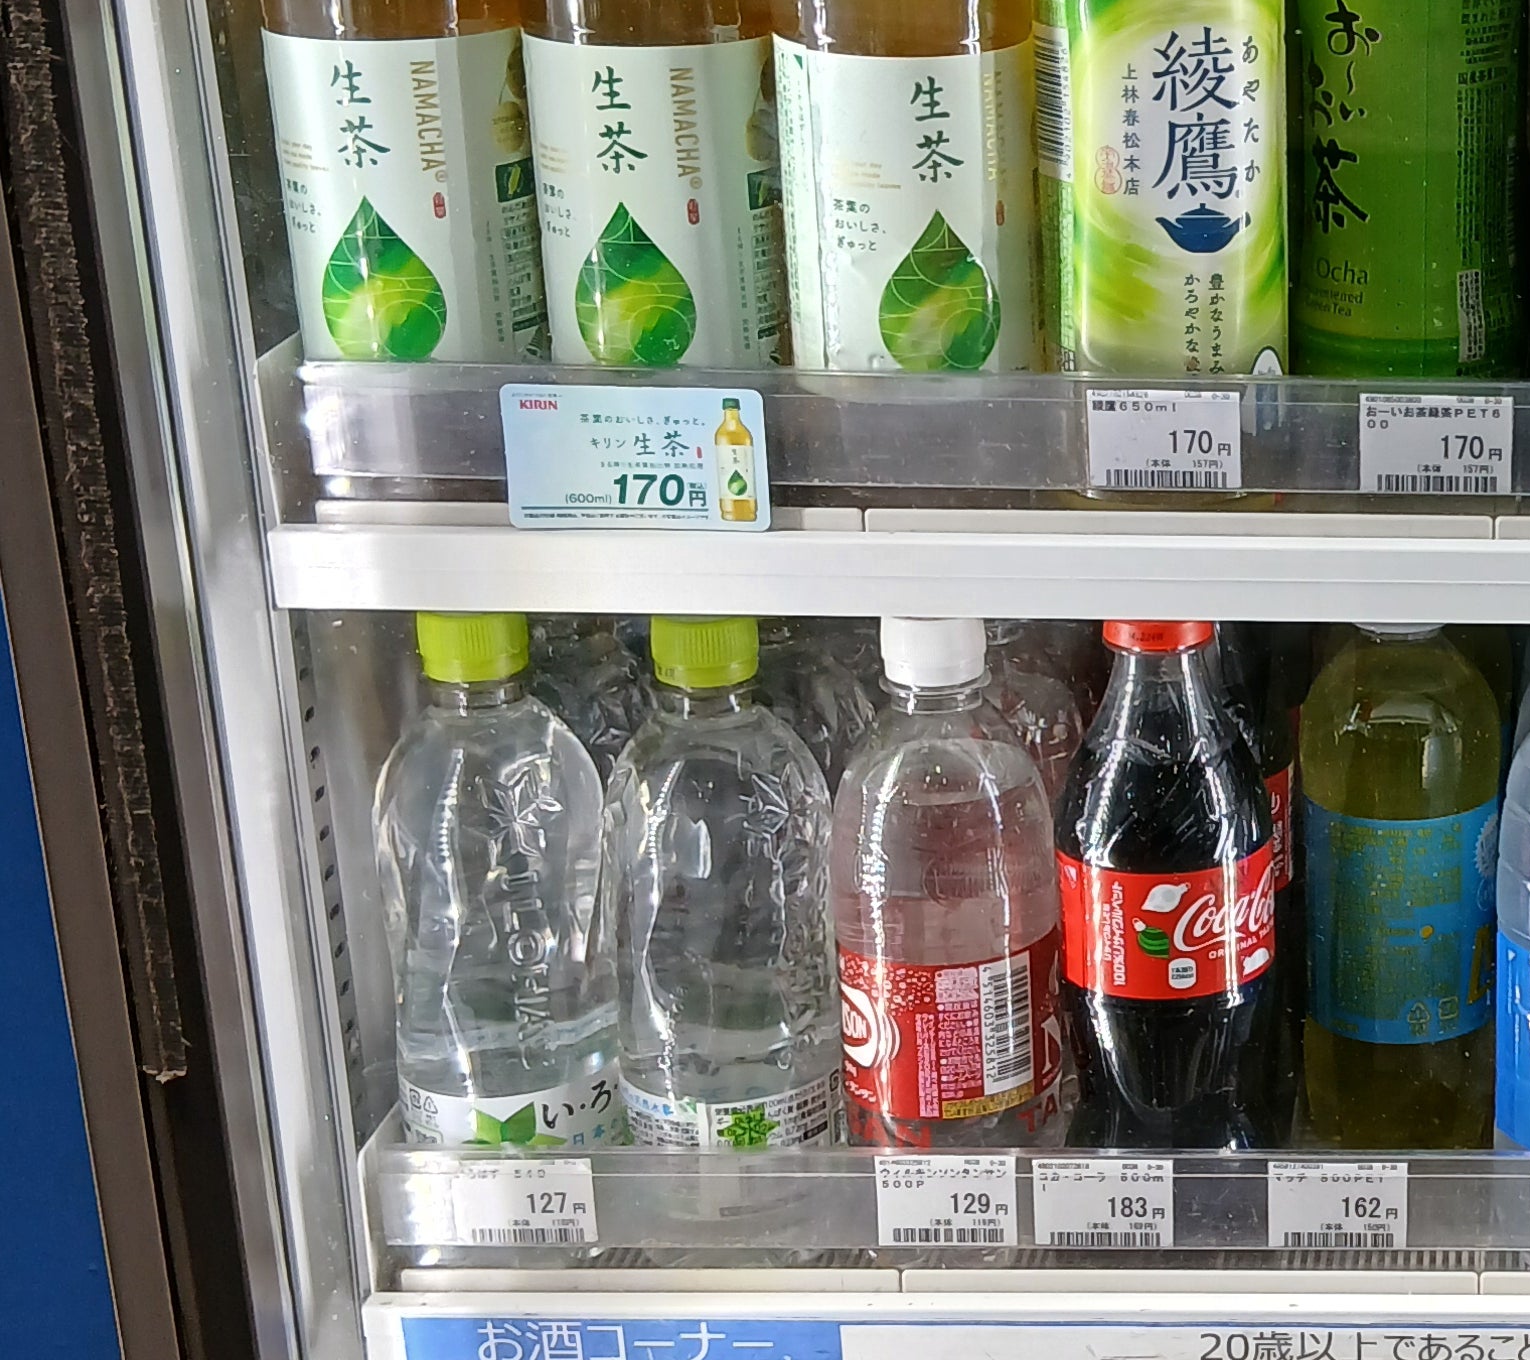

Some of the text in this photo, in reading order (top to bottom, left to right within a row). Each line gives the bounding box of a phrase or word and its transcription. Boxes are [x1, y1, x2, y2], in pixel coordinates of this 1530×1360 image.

[331, 59, 391, 171] 生茶
[591, 65, 649, 176] 生茶
[910, 75, 966, 185] 生茶
[1121, 63, 1141, 196] 上林春松本店
[1152, 27, 1241, 200] 綾鷹
[1242, 35, 1261, 183] あやたか
[519, 400, 558, 411] KIRIN
